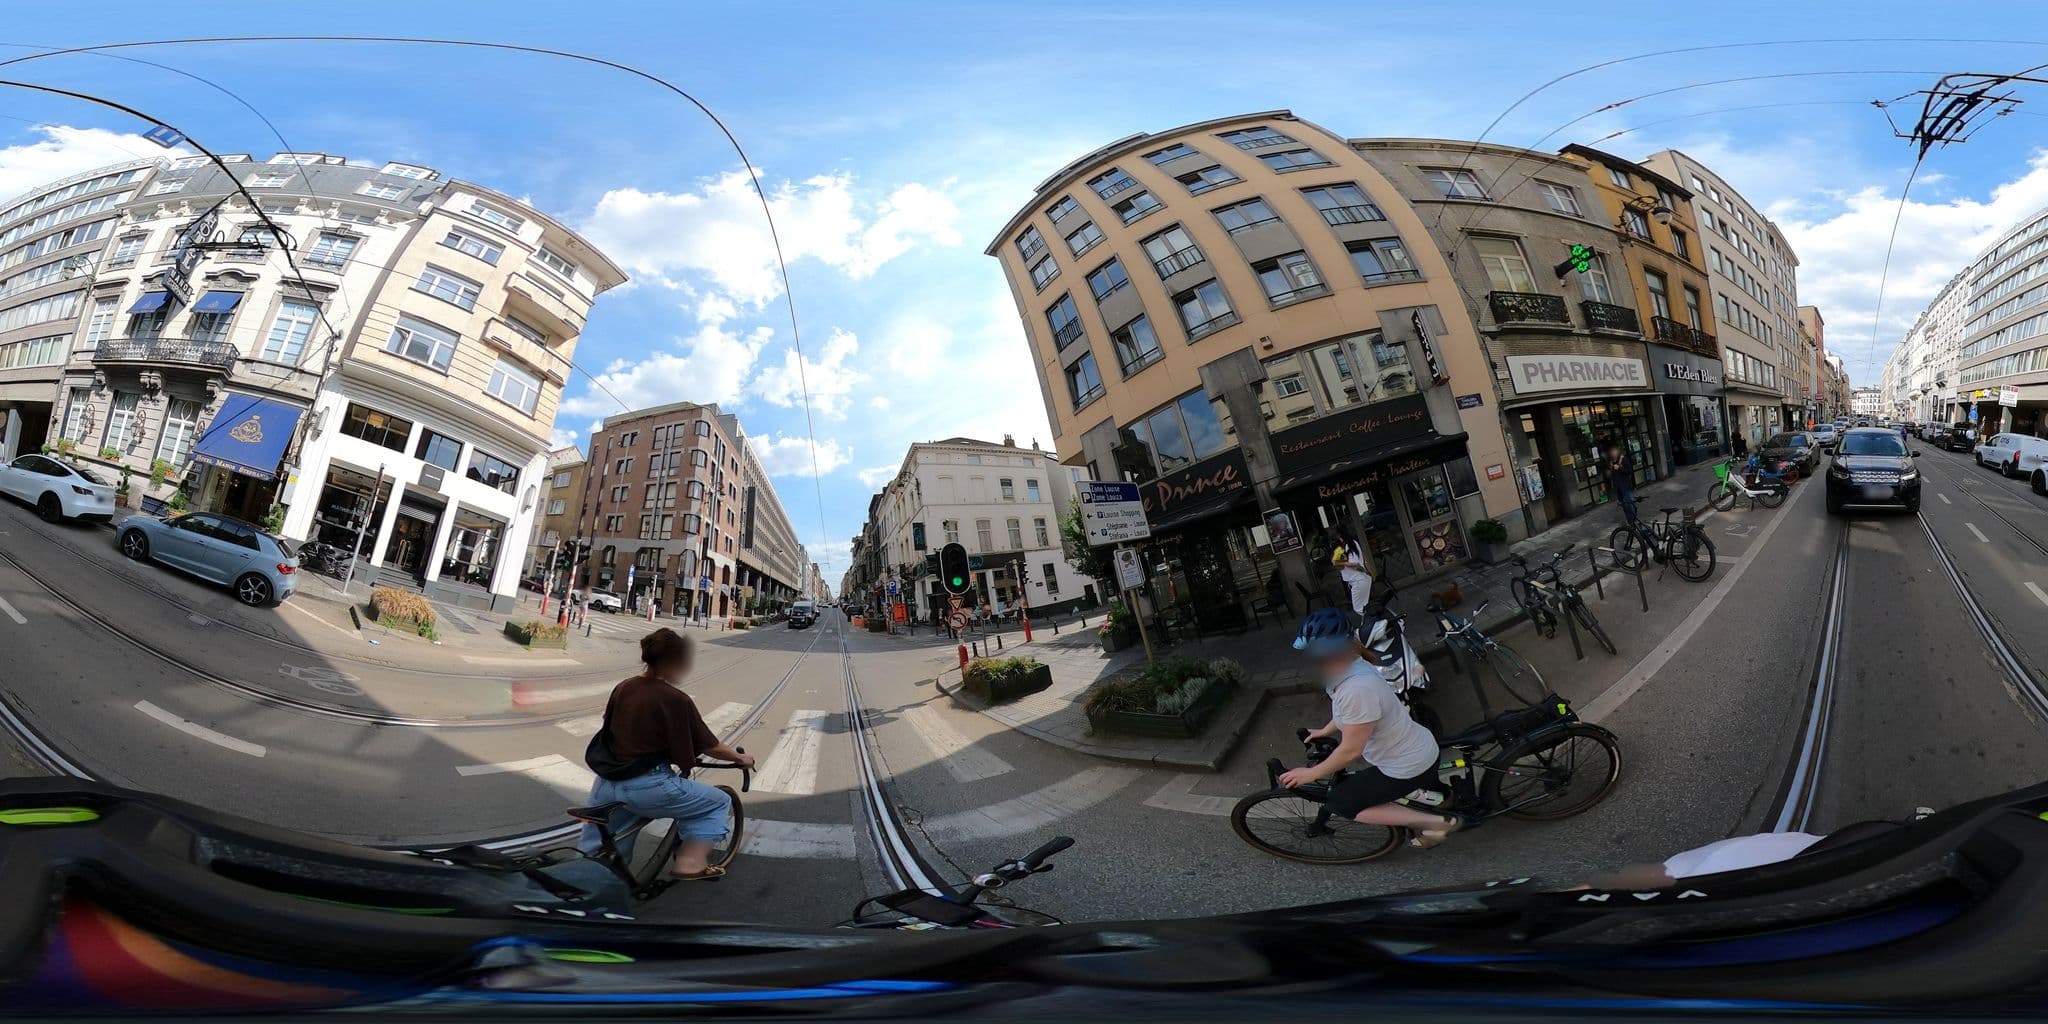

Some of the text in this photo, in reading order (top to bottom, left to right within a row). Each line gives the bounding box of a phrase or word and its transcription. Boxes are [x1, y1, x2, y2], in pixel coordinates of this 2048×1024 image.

[1522, 362, 1639, 384] PHARMACIE
[1667, 364, 1719, 384] L'Eden Bleu
[1280, 409, 1424, 454] Restaurant Coffee Lounge
[1157, 464, 1238, 511] Prince
[1318, 471, 1379, 498] Restaurant
[1387, 457, 1431, 477] Traiteur
